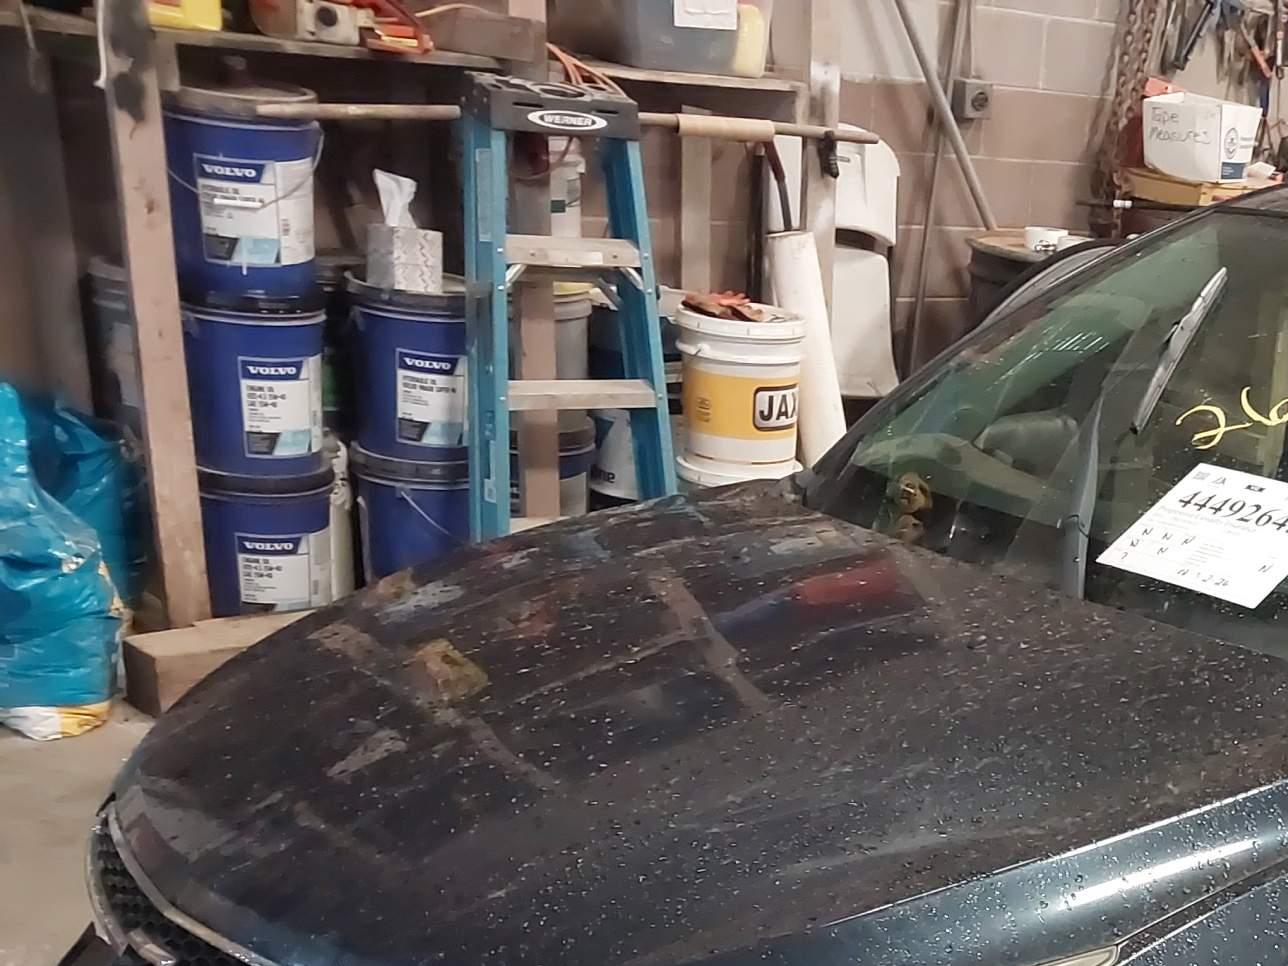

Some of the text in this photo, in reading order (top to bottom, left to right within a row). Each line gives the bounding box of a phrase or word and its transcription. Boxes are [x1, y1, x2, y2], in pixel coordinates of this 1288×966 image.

[543, 114, 592, 126] WERNER
[201, 163, 257, 178] VOLVO
[403, 357, 452, 370] VOLVO
[246, 365, 297, 375] VOLVO
[243, 541, 295, 551] VOLVO
